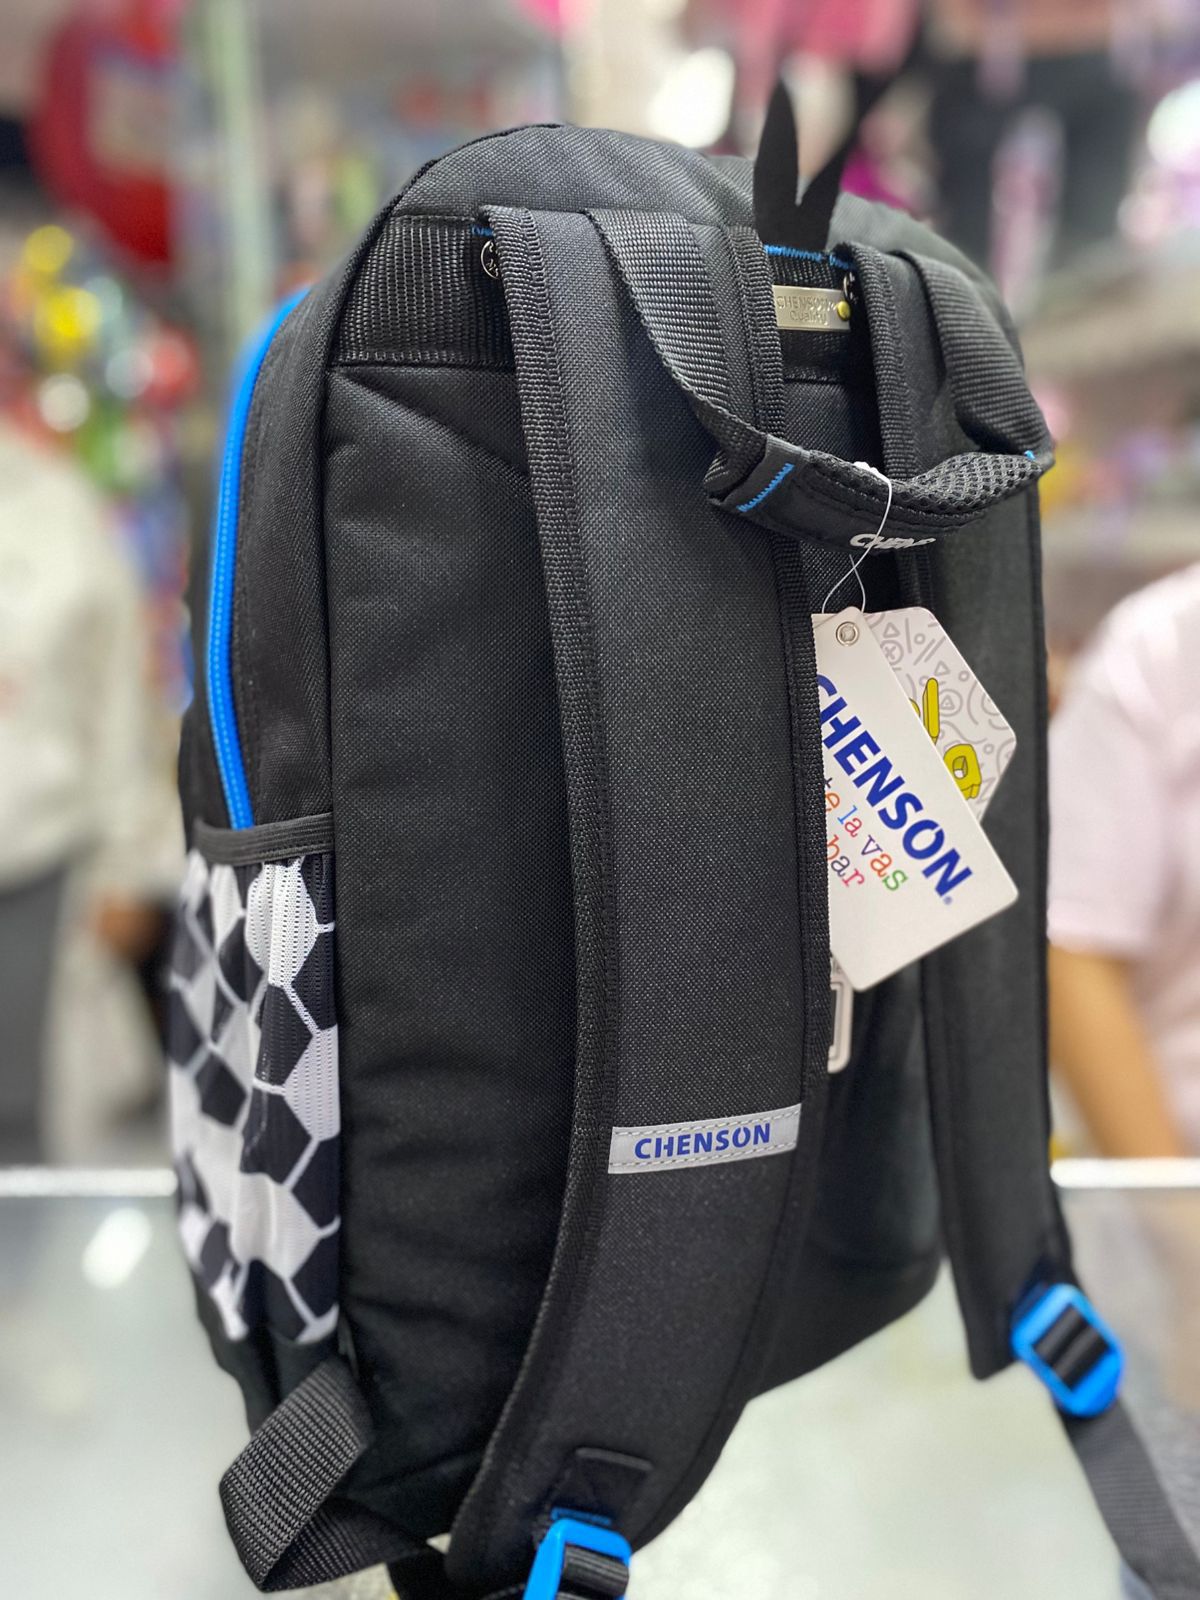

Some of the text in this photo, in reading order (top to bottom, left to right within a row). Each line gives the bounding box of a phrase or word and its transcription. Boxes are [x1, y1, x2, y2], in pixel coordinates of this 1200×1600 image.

[837, 805, 863, 838] la
[861, 834, 908, 892] vas
[635, 1123, 770, 1159] CHENSON
